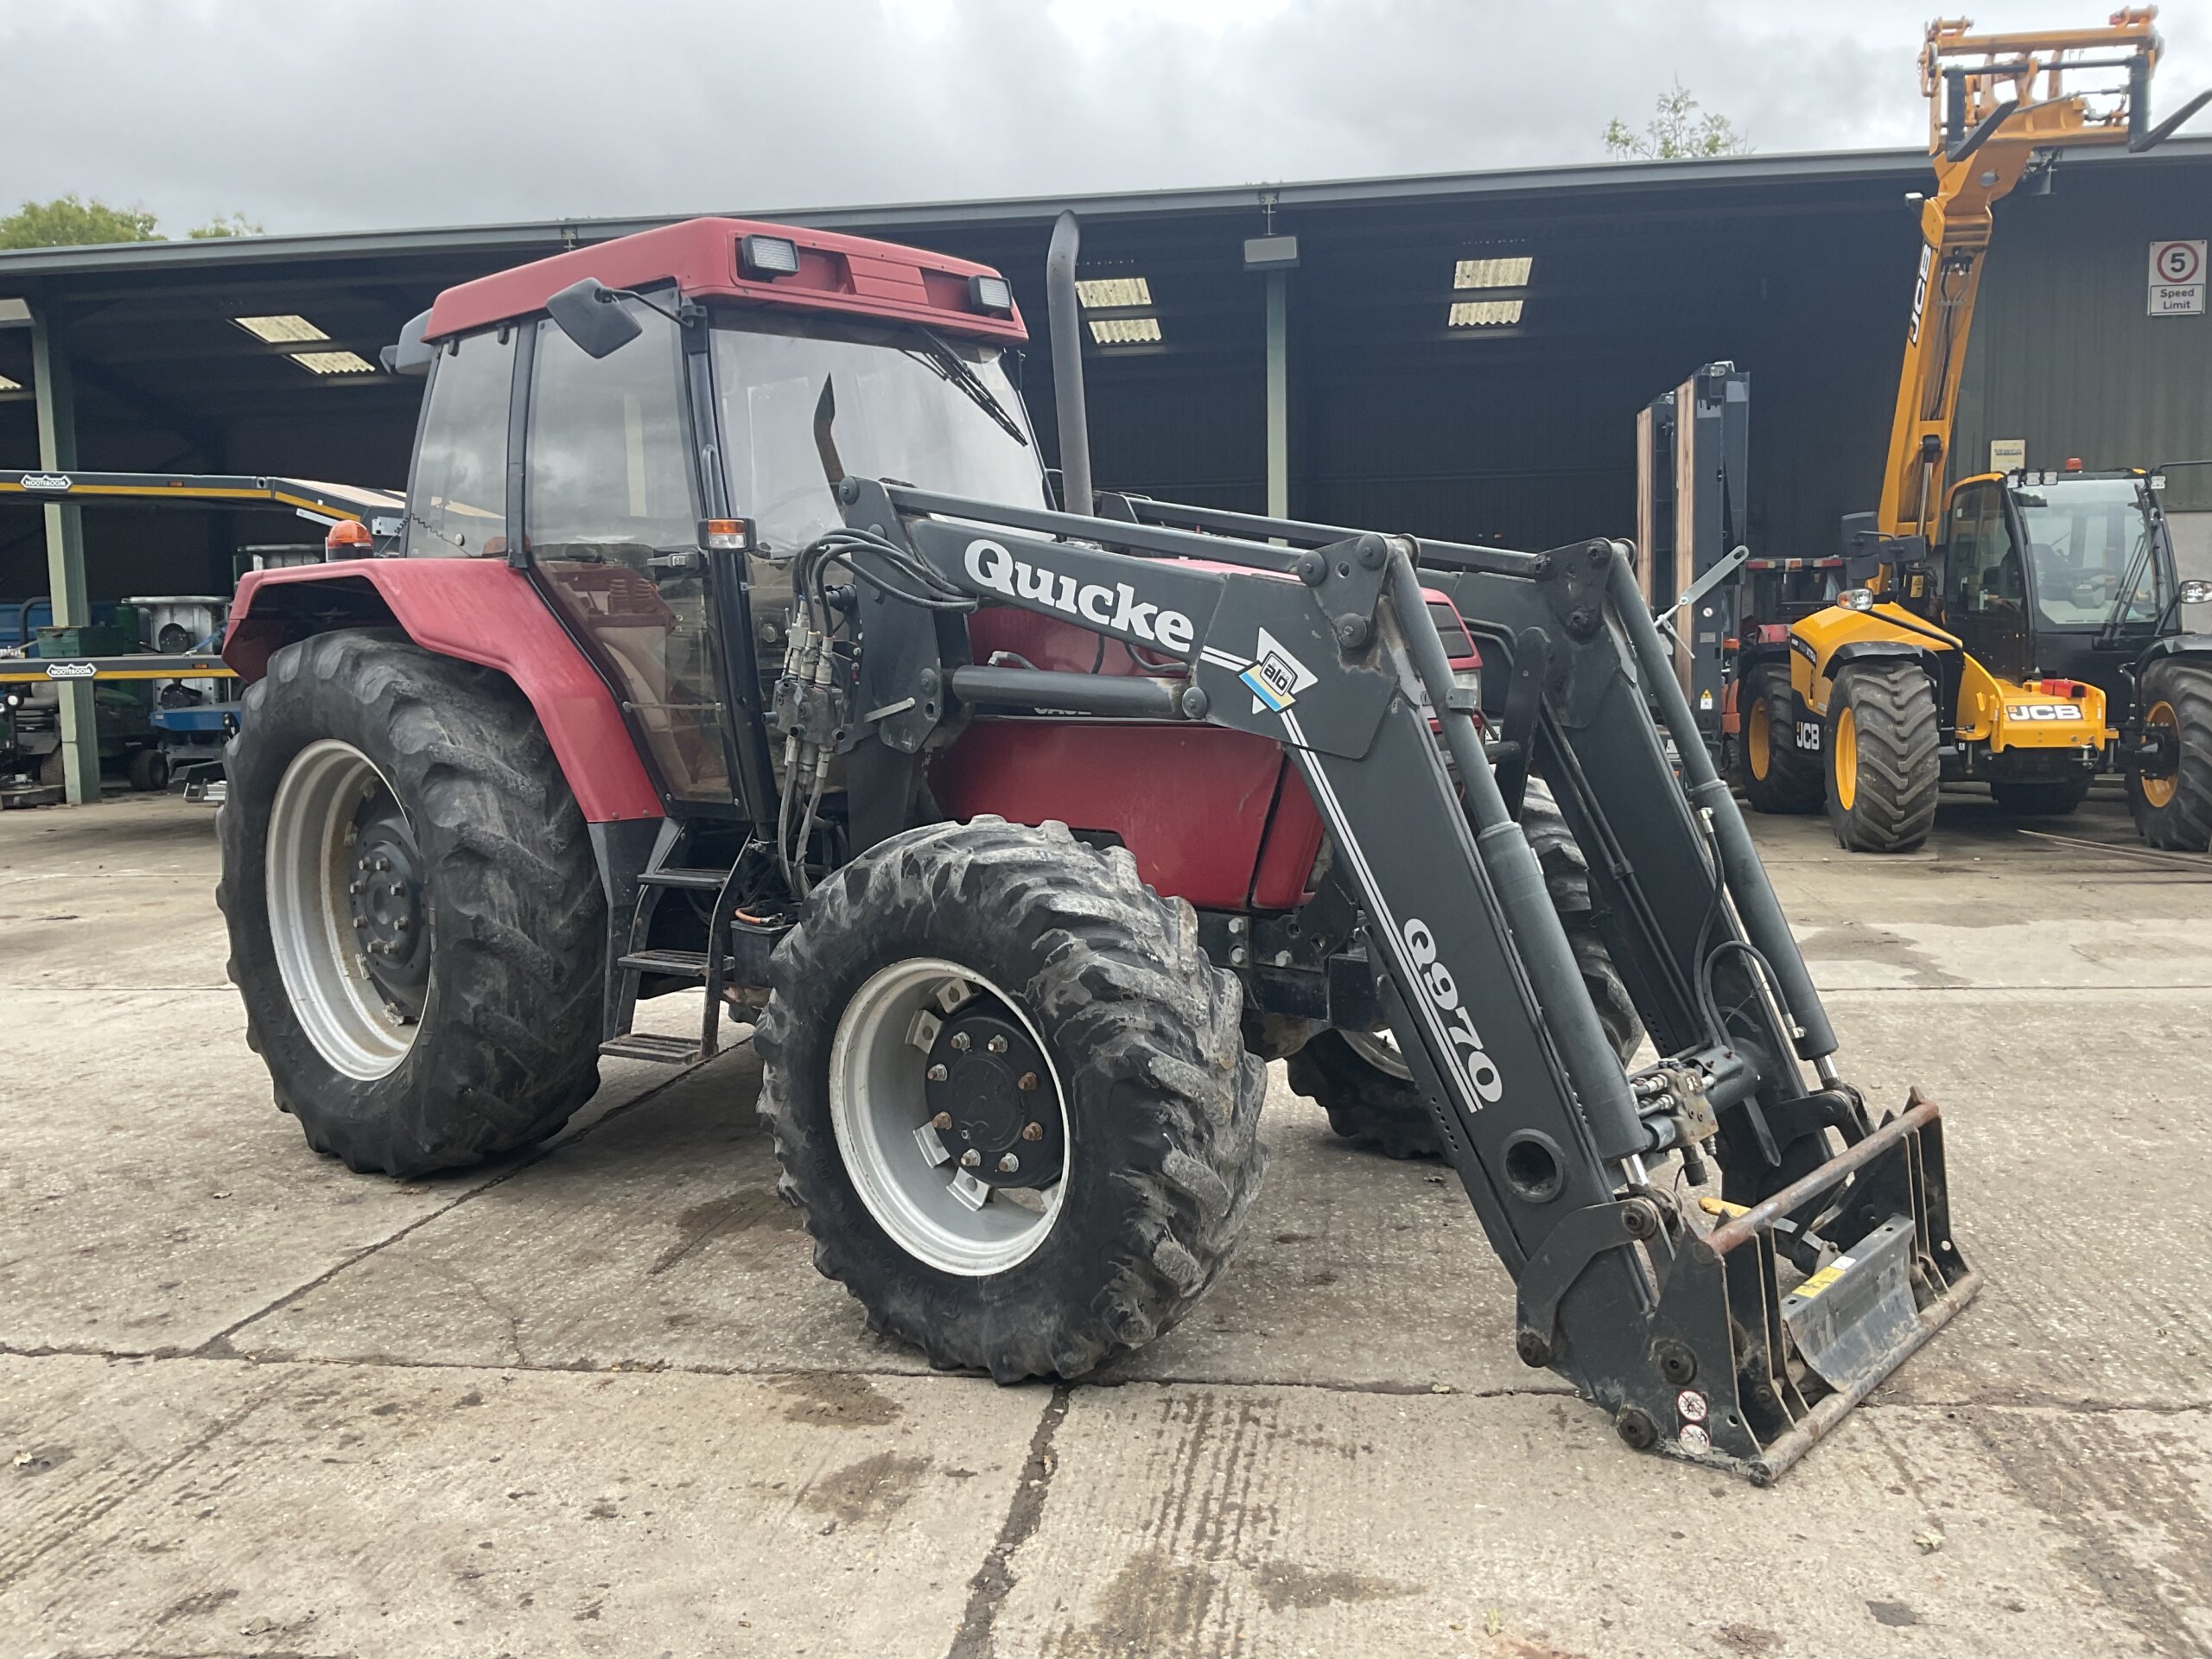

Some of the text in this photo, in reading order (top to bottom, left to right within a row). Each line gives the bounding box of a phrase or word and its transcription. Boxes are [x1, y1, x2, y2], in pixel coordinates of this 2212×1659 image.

[2170, 252, 2186, 273] 5
[1910, 243, 1933, 345] JCB
[2159, 288, 2196, 300] Speed
[2163, 301, 2191, 310] Limit
[963, 538, 1194, 652] Quicke
[2008, 705, 2082, 721] JCB
[1796, 721, 1820, 750] JCB
[1403, 918, 1503, 1103] Q970
